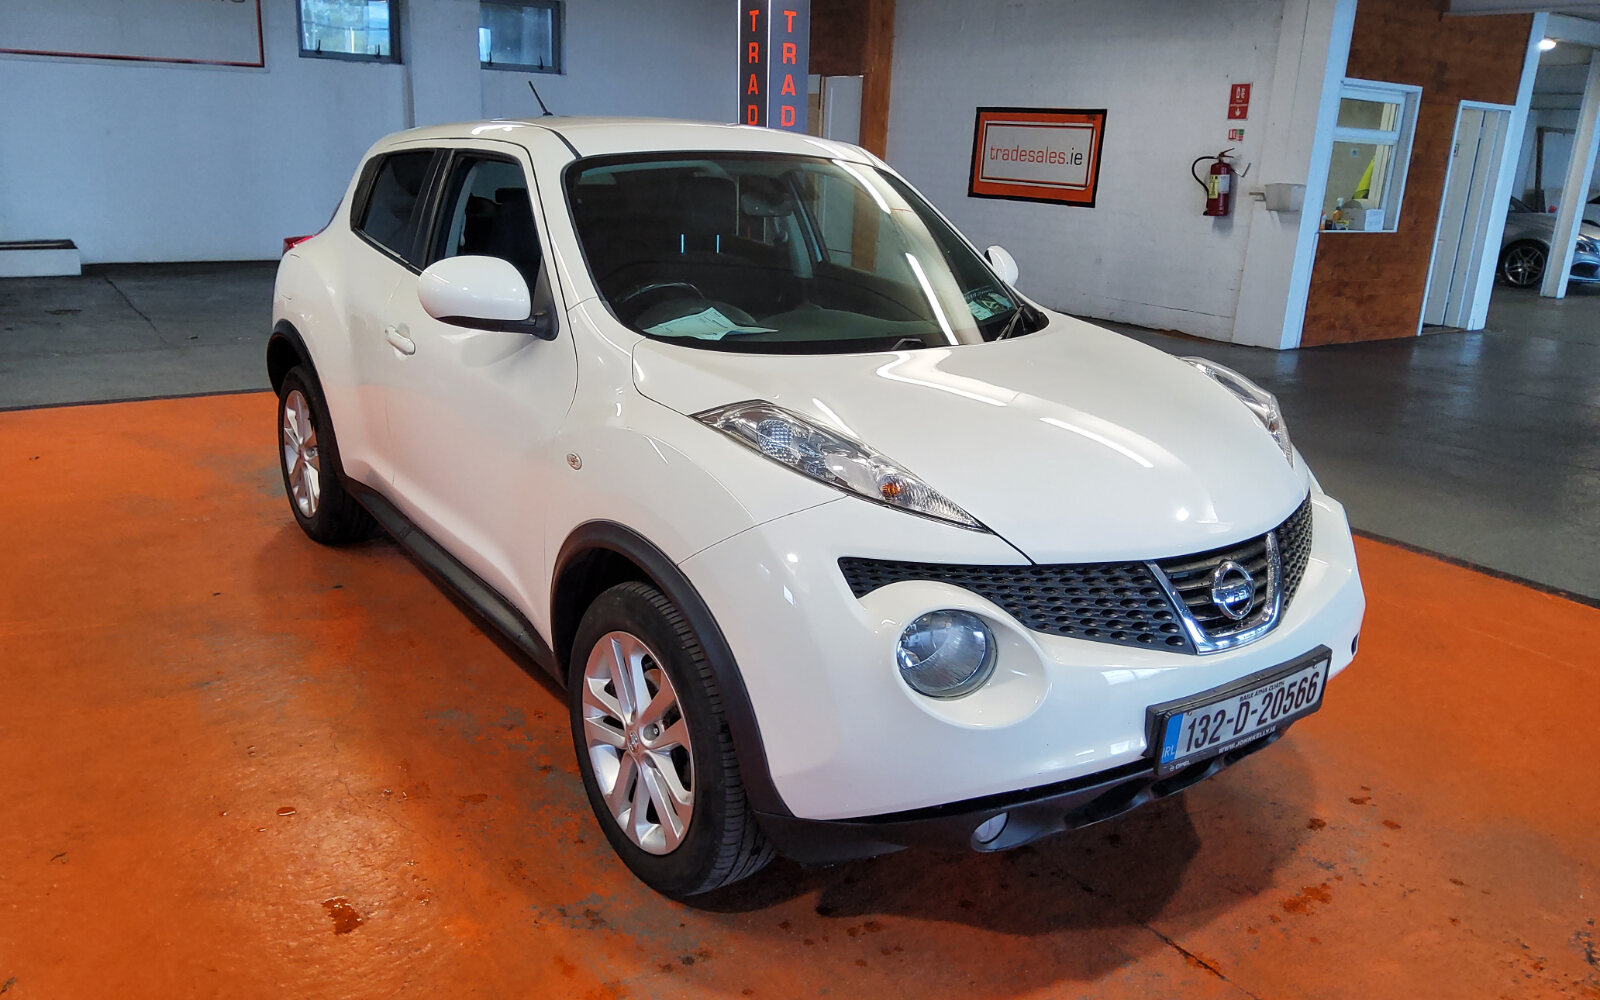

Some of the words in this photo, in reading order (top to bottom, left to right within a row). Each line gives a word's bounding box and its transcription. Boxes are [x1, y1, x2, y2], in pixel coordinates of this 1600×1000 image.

[780, 10, 797, 127] TRAD
[990, 144, 1083, 166] tradesales.ie
[1186, 671, 1320, 753] 132-D-20566
[1161, 744, 1176, 759] IRL
